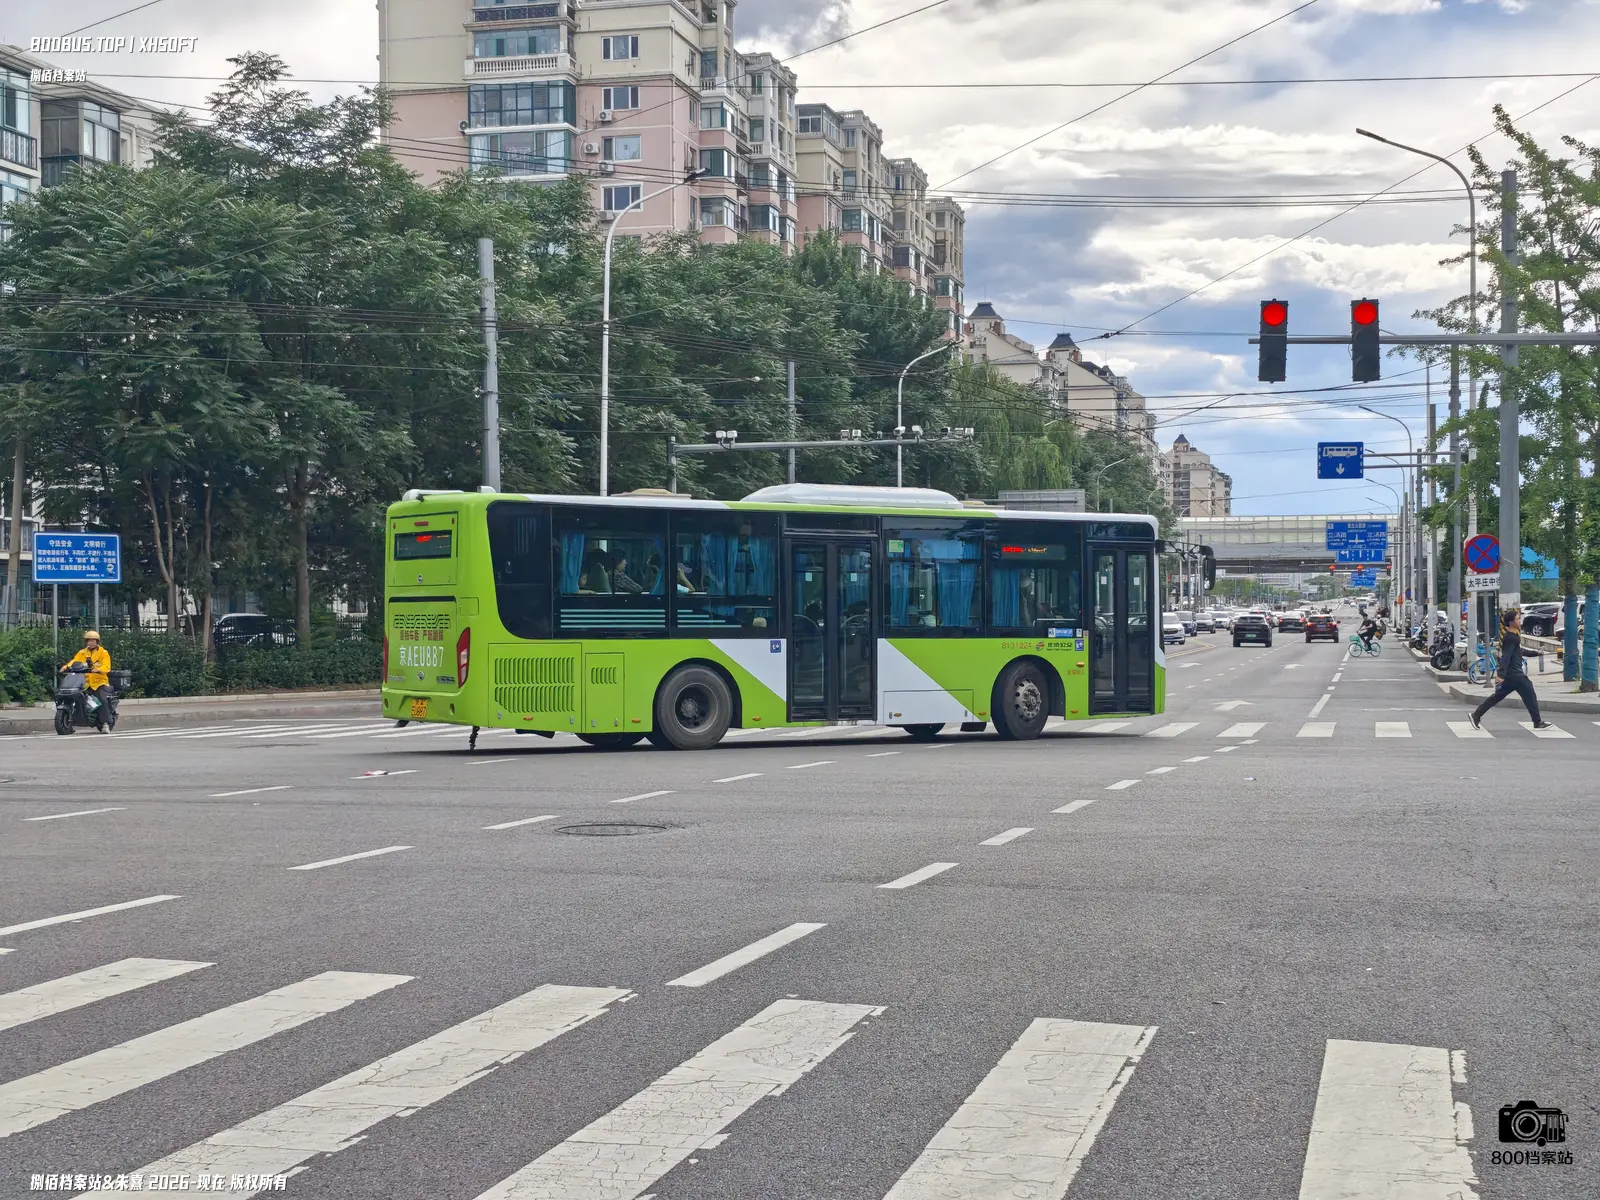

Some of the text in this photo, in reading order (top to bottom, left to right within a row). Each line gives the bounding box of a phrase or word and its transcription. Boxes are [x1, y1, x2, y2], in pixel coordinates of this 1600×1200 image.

[83, 540, 106, 548] 文明骑行
[399, 645, 444, 667] 京AEU887
